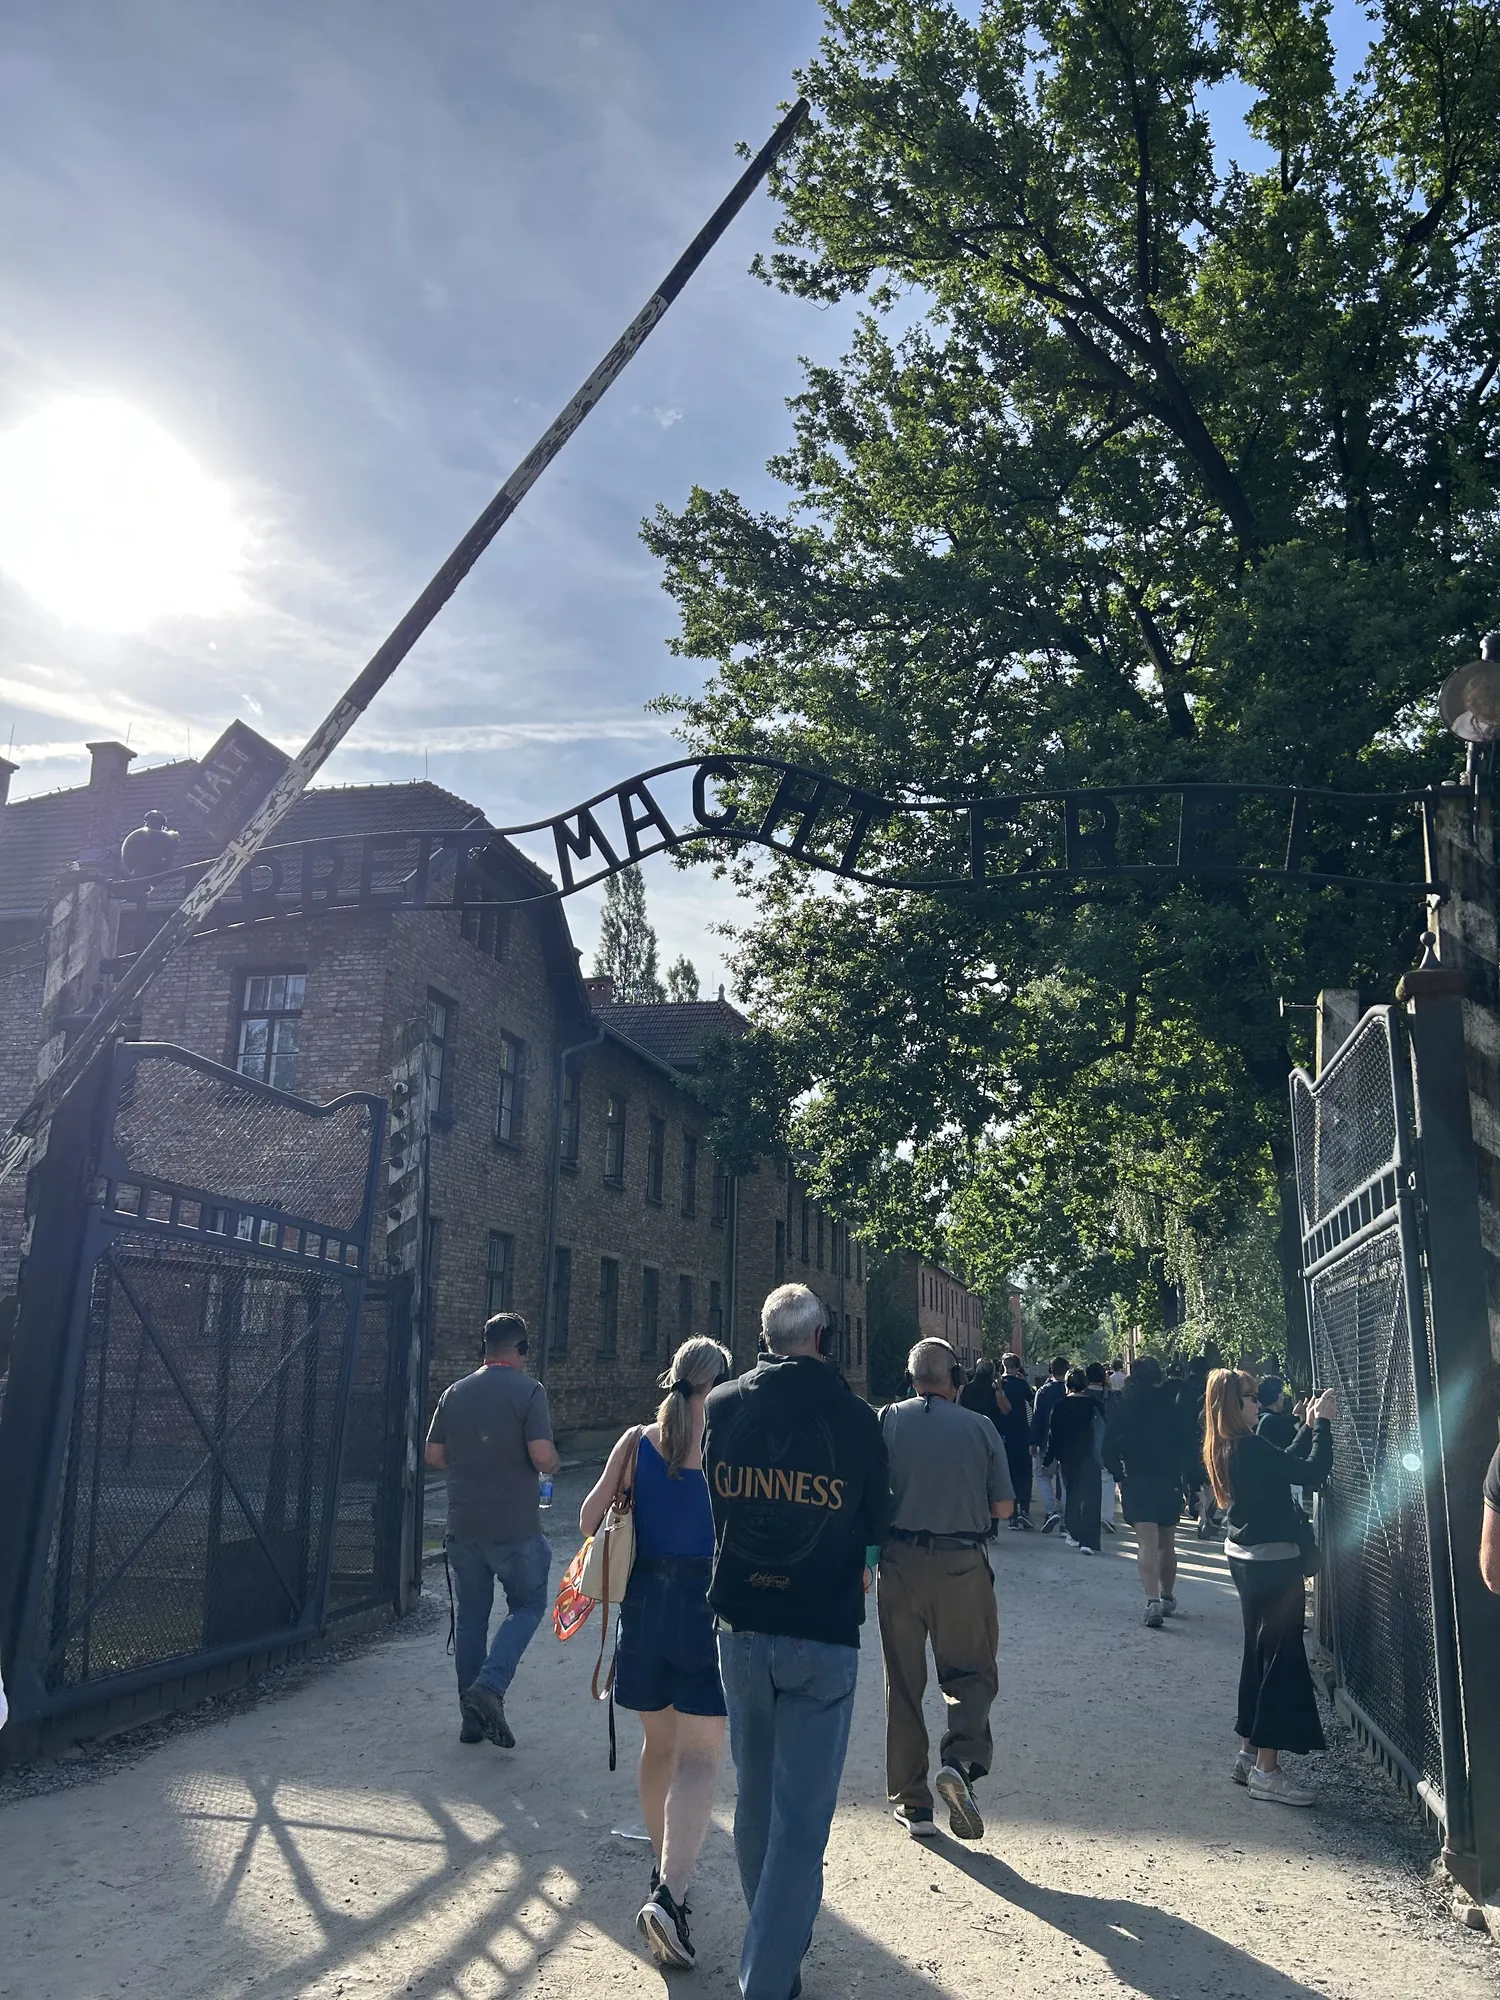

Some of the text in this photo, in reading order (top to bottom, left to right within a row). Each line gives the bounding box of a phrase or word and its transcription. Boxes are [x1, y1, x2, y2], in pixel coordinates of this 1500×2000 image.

[185, 738, 249, 814] HALT
[552, 760, 894, 893] MACHT
[968, 784, 1308, 880] FREI
[714, 1460, 845, 1510] GUINNESS
